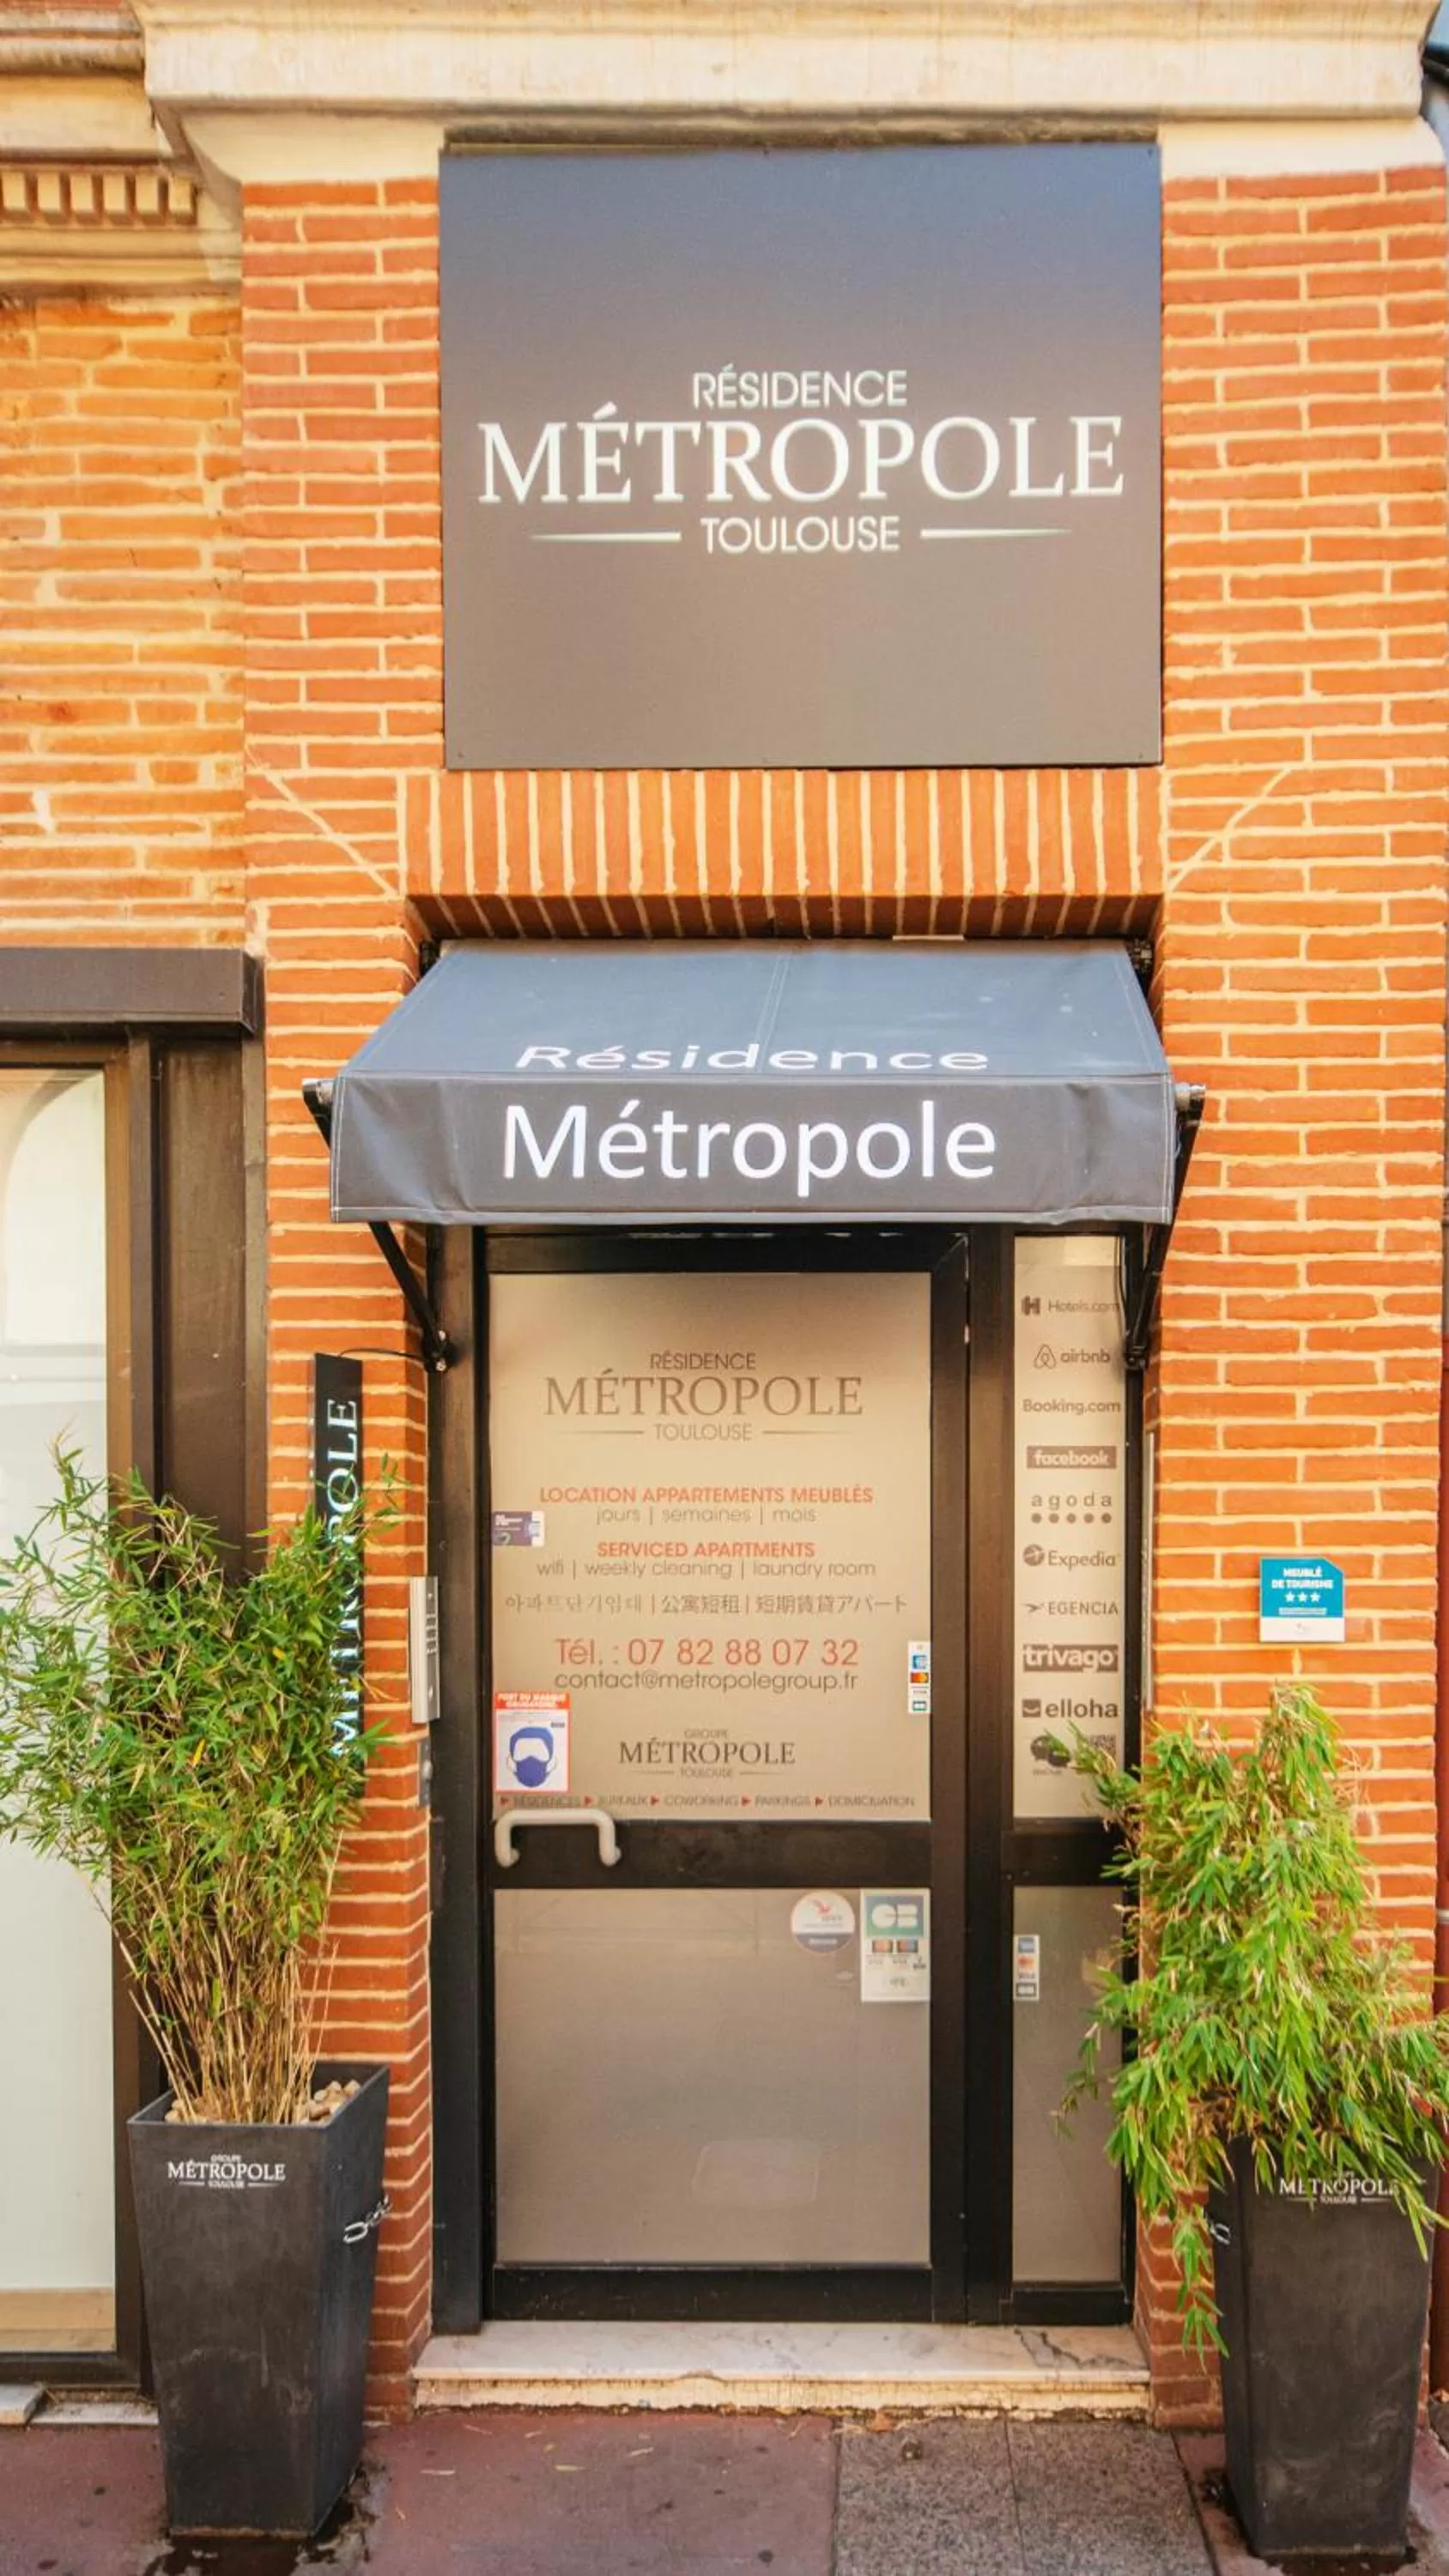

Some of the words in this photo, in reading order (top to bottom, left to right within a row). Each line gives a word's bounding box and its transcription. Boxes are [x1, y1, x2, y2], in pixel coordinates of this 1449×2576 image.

[693, 364, 907, 408] RÉSIDENCE
[477, 401, 1125, 504] MÉTROPOLE
[700, 516, 900, 554] TOULOUSE
[516, 1042, 989, 1072] Résidence
[503, 1099, 996, 1197] Métropole
[650, 1350, 756, 1370] RÉSIDENCE
[1061, 1349, 1111, 1364] airbnb
[544, 1368, 864, 1416] MÉTROPOLE
[1023, 1399, 1121, 1415] Booking.com
[654, 1424, 752, 1441] TOULOUSE
[1034, 1449, 1109, 1466] facebook
[540, 1487, 636, 1504] LOCATION
[642, 1487, 784, 1504] APPARTEMENTS
[791, 1484, 873, 1504] MEUBLÉS
[1031, 1492, 1112, 1510] agoda
[596, 1507, 640, 1525] jours
[662, 1507, 751, 1522] semaines
[773, 1507, 816, 1522] mois
[597, 1541, 688, 1558] SERVICED
[694, 1541, 815, 1558] APARTMENTS
[537, 1558, 564, 1577] wifi
[585, 1558, 646, 1579] weekly
[652, 1558, 732, 1579] cleaning
[753, 1558, 822, 1579] laundry
[828, 1563, 876, 1577] room
[1048, 1551, 1116, 1571] Expedia
[1048, 1601, 1119, 1615] EGENCIA
[627, 1637, 664, 1666] 07
[676, 1637, 712, 1666] 82
[724, 1637, 762, 1666] 88
[773, 1637, 809, 1666] 07
[821, 1637, 859, 1666] 32
[1023, 1644, 1114, 1670] trivago
[555, 1671, 858, 1693] contact@metropolegroup.fr
[1045, 1699, 1119, 1718] elloha
[619, 1737, 796, 1765] MÉTROPOLE
[167, 2159, 286, 2181] MÉTROPOLE
